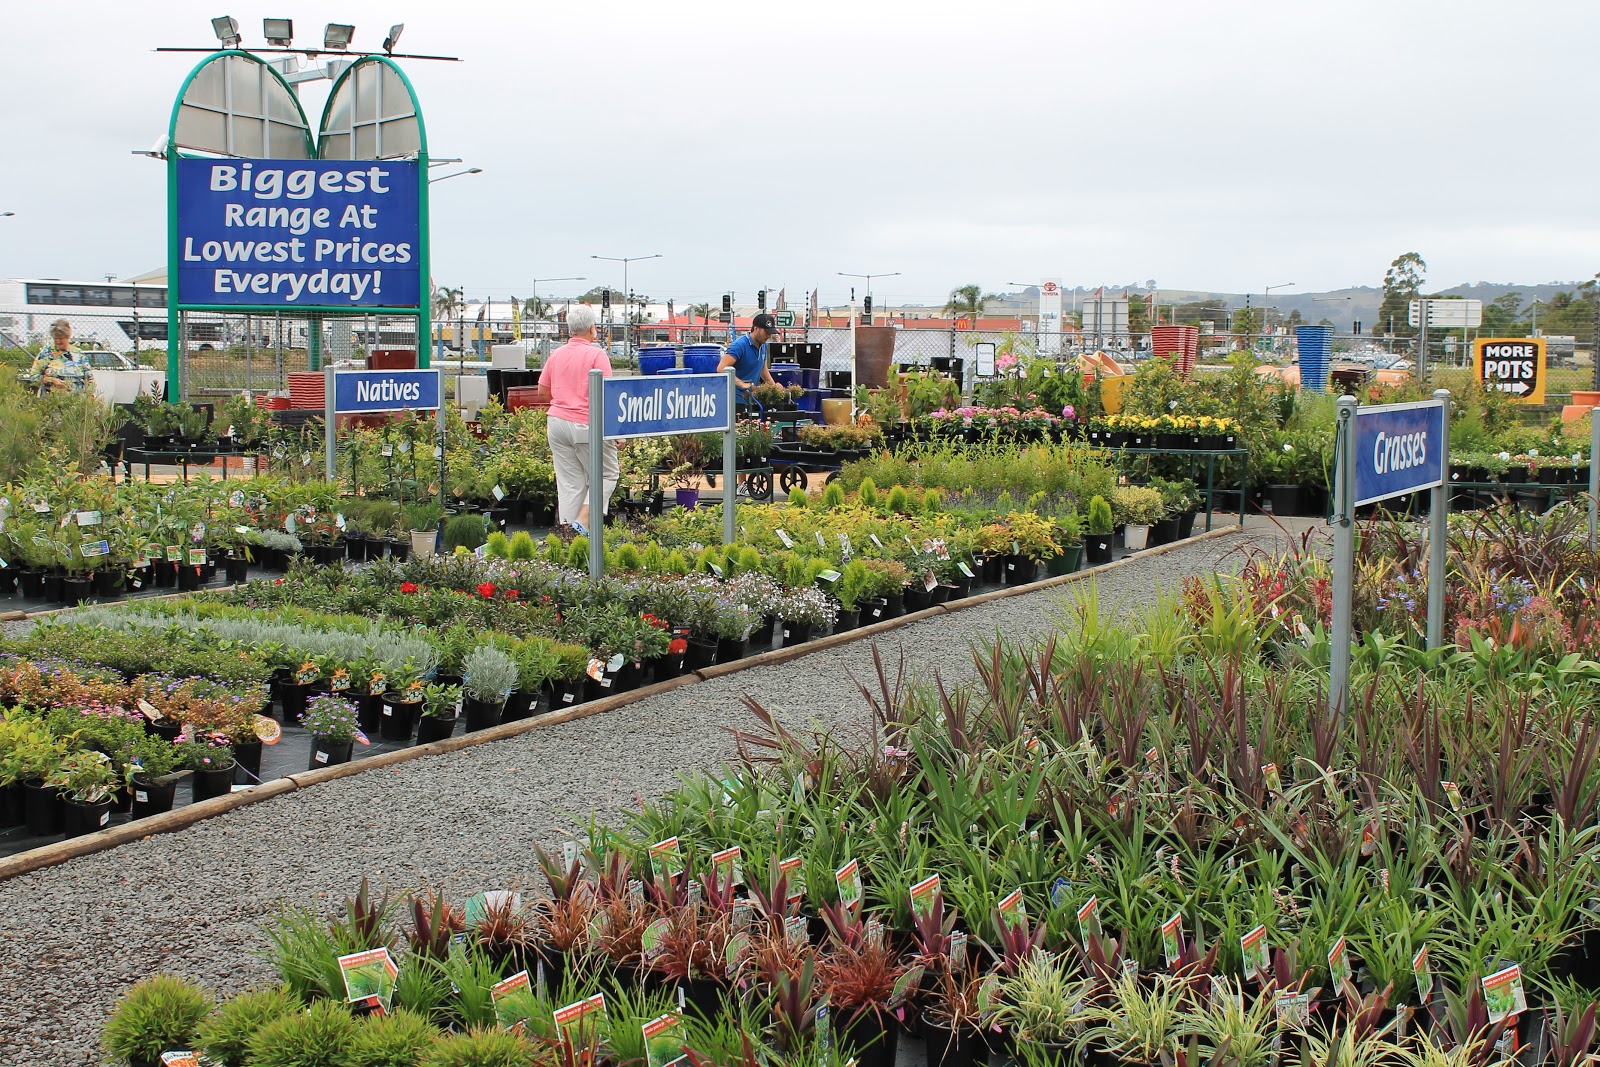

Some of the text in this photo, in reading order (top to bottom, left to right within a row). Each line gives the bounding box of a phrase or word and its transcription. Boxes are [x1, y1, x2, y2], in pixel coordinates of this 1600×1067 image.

[209, 162, 390, 200] Biggest
[225, 203, 378, 236] Range At
[184, 236, 412, 264] Lowest Prices
[213, 268, 382, 302] Everyday!
[1486, 345, 1534, 358] MORE
[1484, 360, 1534, 379] POTS
[356, 379, 420, 402] Natives
[617, 387, 716, 423] Small Shrubs
[1374, 431, 1427, 475] Grasses
